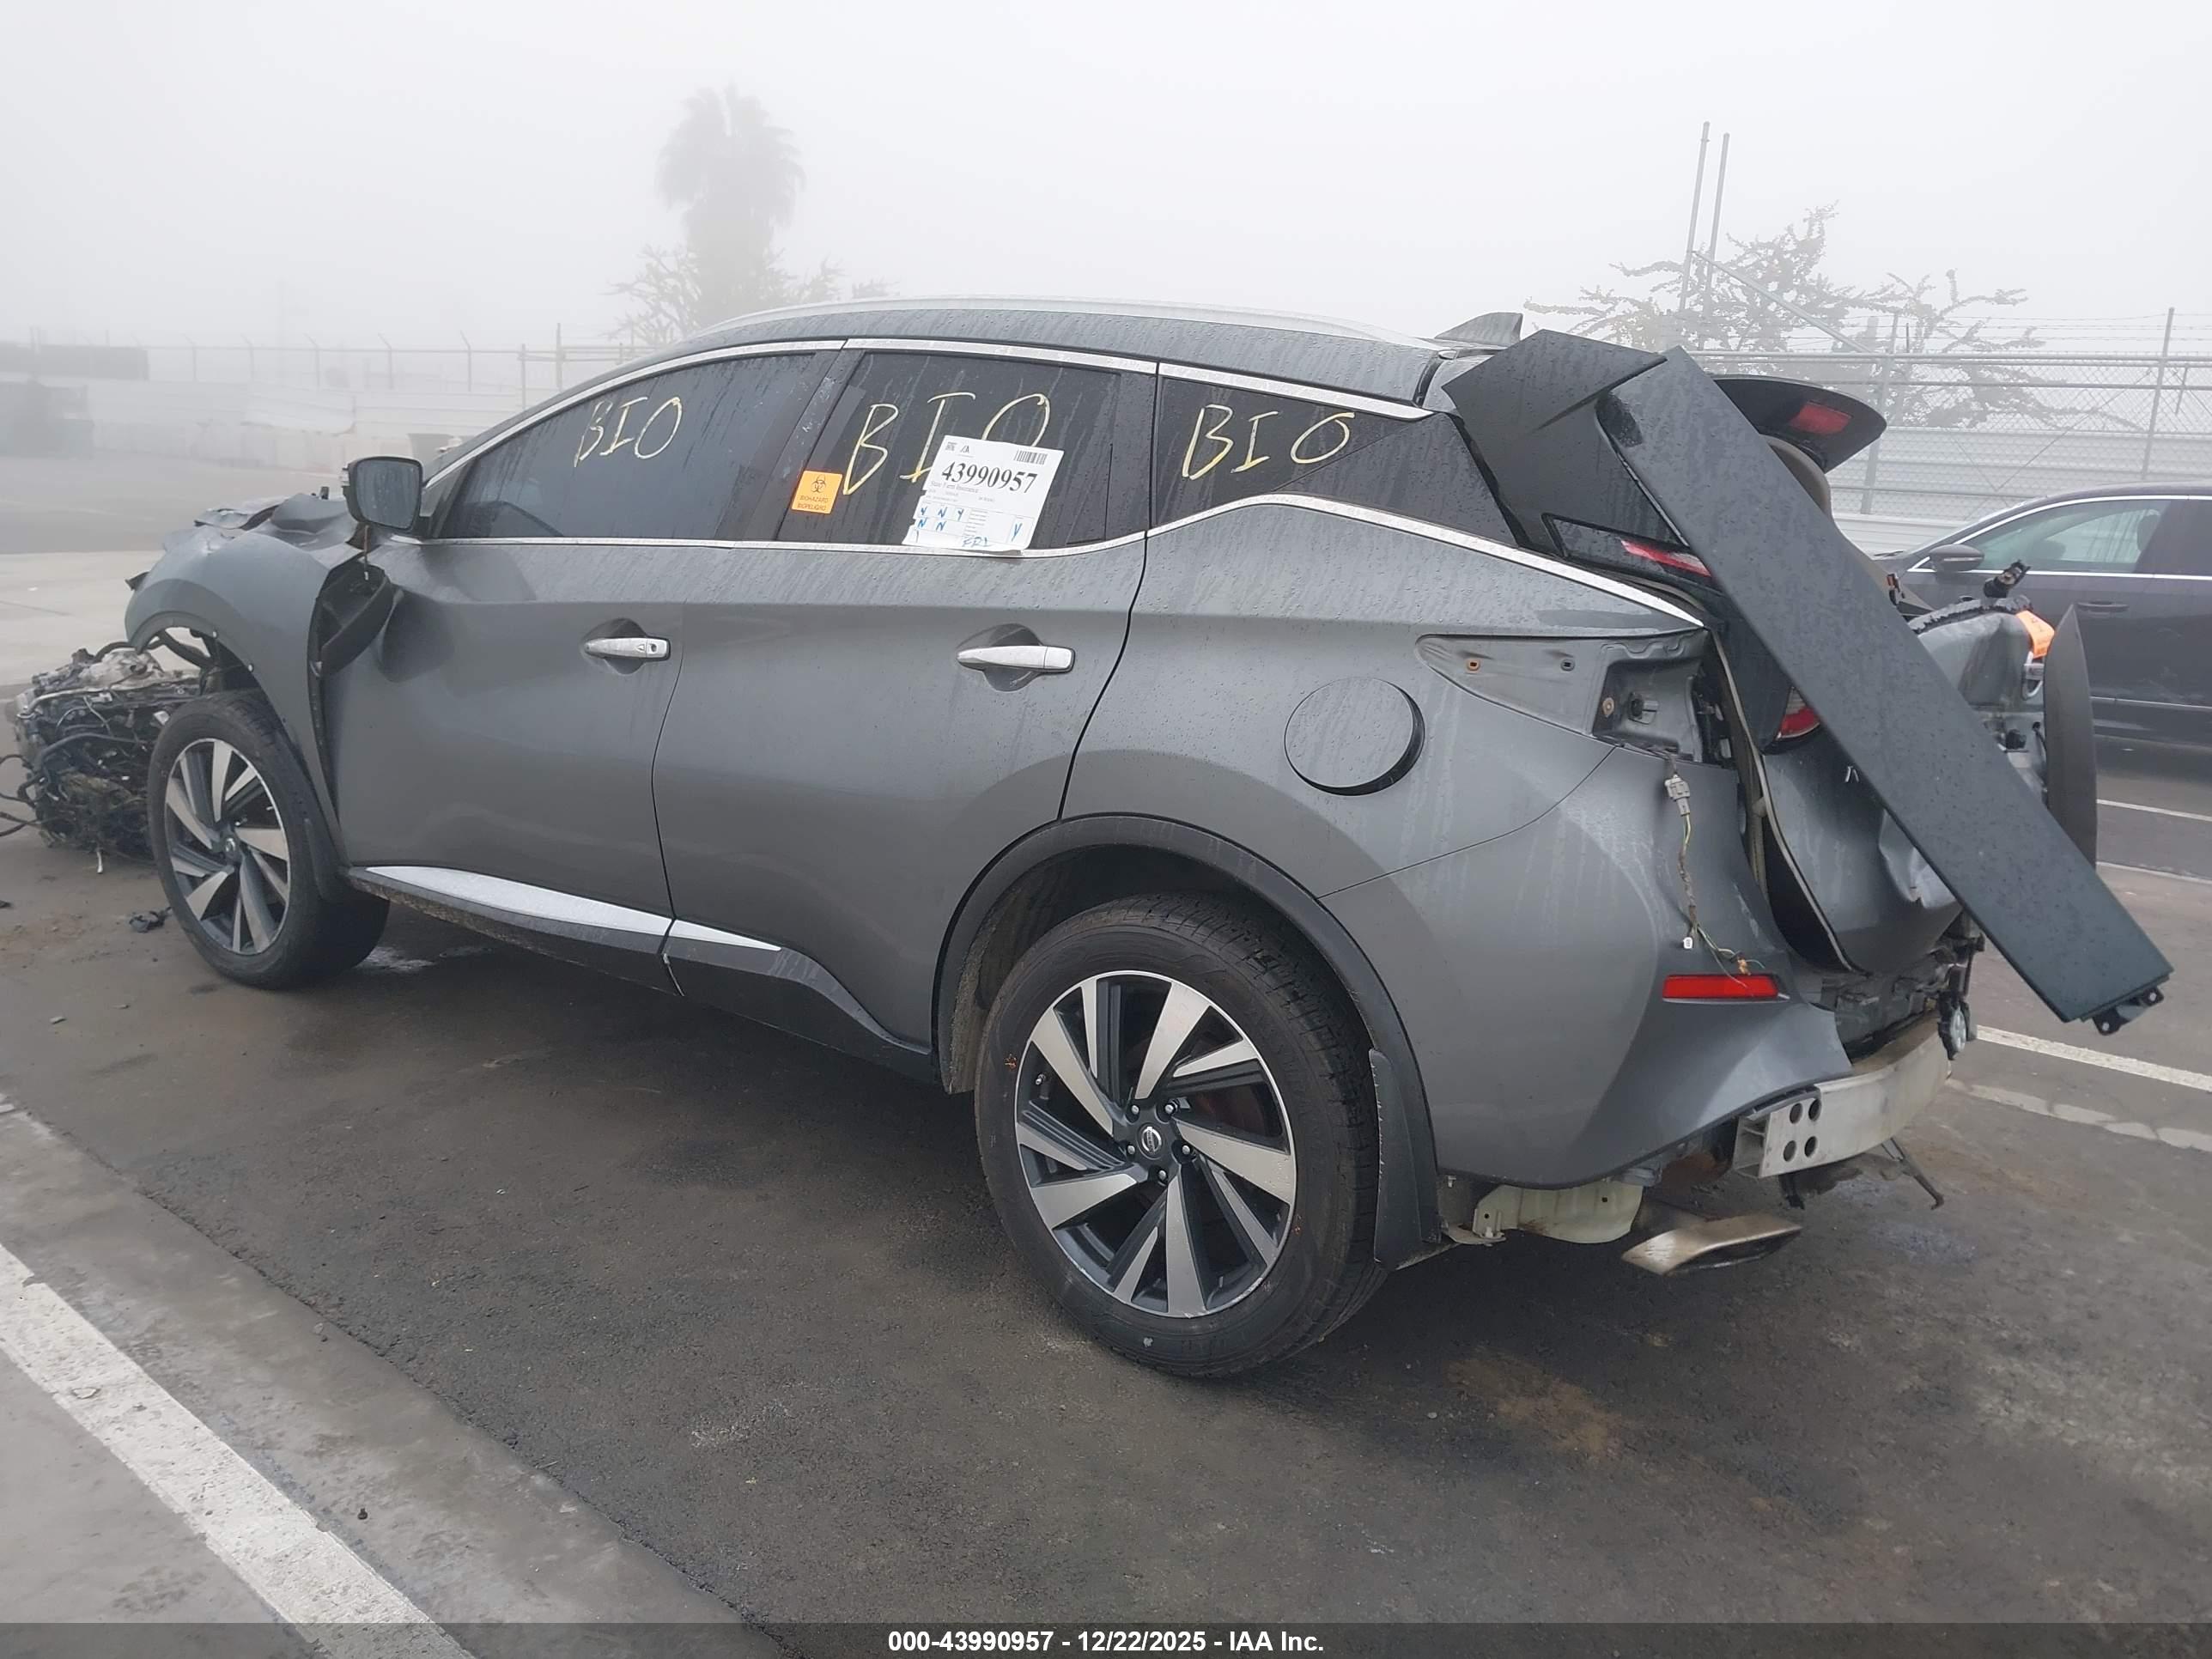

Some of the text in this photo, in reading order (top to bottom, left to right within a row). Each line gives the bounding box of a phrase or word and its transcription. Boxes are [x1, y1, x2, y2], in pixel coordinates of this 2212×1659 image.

[574, 397, 683, 467] BIO
[1182, 404, 1356, 481] BIO
[941, 461, 1038, 494] 43990957
